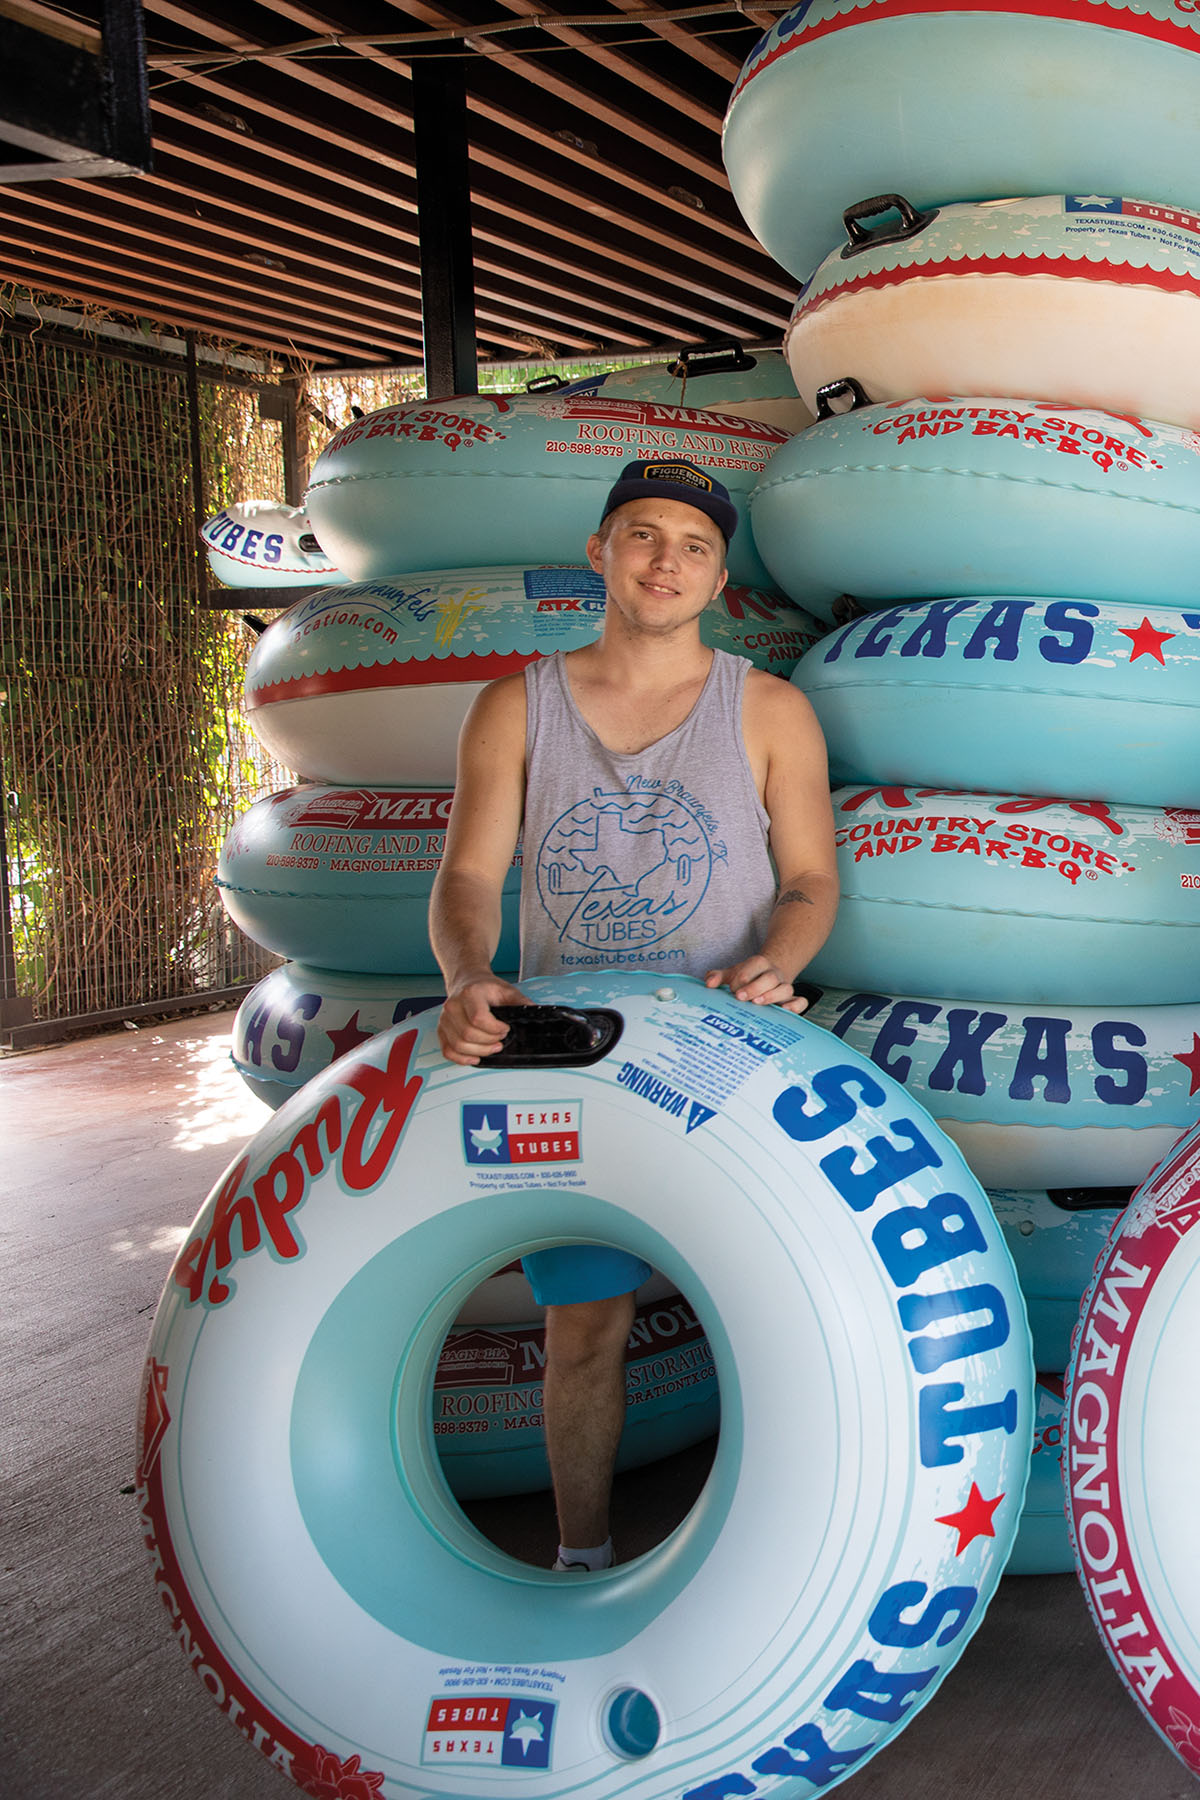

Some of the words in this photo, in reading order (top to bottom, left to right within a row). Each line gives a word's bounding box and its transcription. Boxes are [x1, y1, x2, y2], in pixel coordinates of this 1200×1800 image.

[1075, 218, 1145, 230] TEXASTUBES.COM
[1107, 227, 1128, 236] Texas
[1130, 230, 1151, 240] Tubes
[328, 431, 363, 458] AND
[577, 423, 676, 447] ROOFING
[682, 434, 725, 453] AND
[897, 422, 964, 446] AND
[546, 441, 623, 457] 210-598-9379
[203, 511, 284, 563] TUBES
[822, 600, 1101, 665] TEXAS
[767, 646, 803, 663] AND
[626, 775, 662, 792] New
[711, 840, 729, 868] TX
[289, 832, 372, 856] ROOFING
[373, 833, 420, 856] AND
[853, 834, 923, 862] AND
[266, 853, 319, 871] 210-598-9379
[556, 871, 689, 943] Texas
[580, 919, 657, 943] TUBES
[560, 949, 686, 966] texastubes.com
[830, 995, 1148, 1106] TEXAS
[616, 1061, 690, 1118] WARNING
[516, 1111, 571, 1125] TEXAS
[517, 1140, 572, 1155] TUBES
[772, 1063, 1019, 1469] TUBES
[441, 1389, 544, 1416] ROOFING
[1070, 1249, 1174, 1706] MAGNOLIA
[136, 1481, 297, 1780] MAGNOLIA
[494, 1677, 553, 1692] TEXASTUBES.COM
[437, 1707, 499, 1722] TUBES
[433, 1740, 494, 1753] TEXAS
